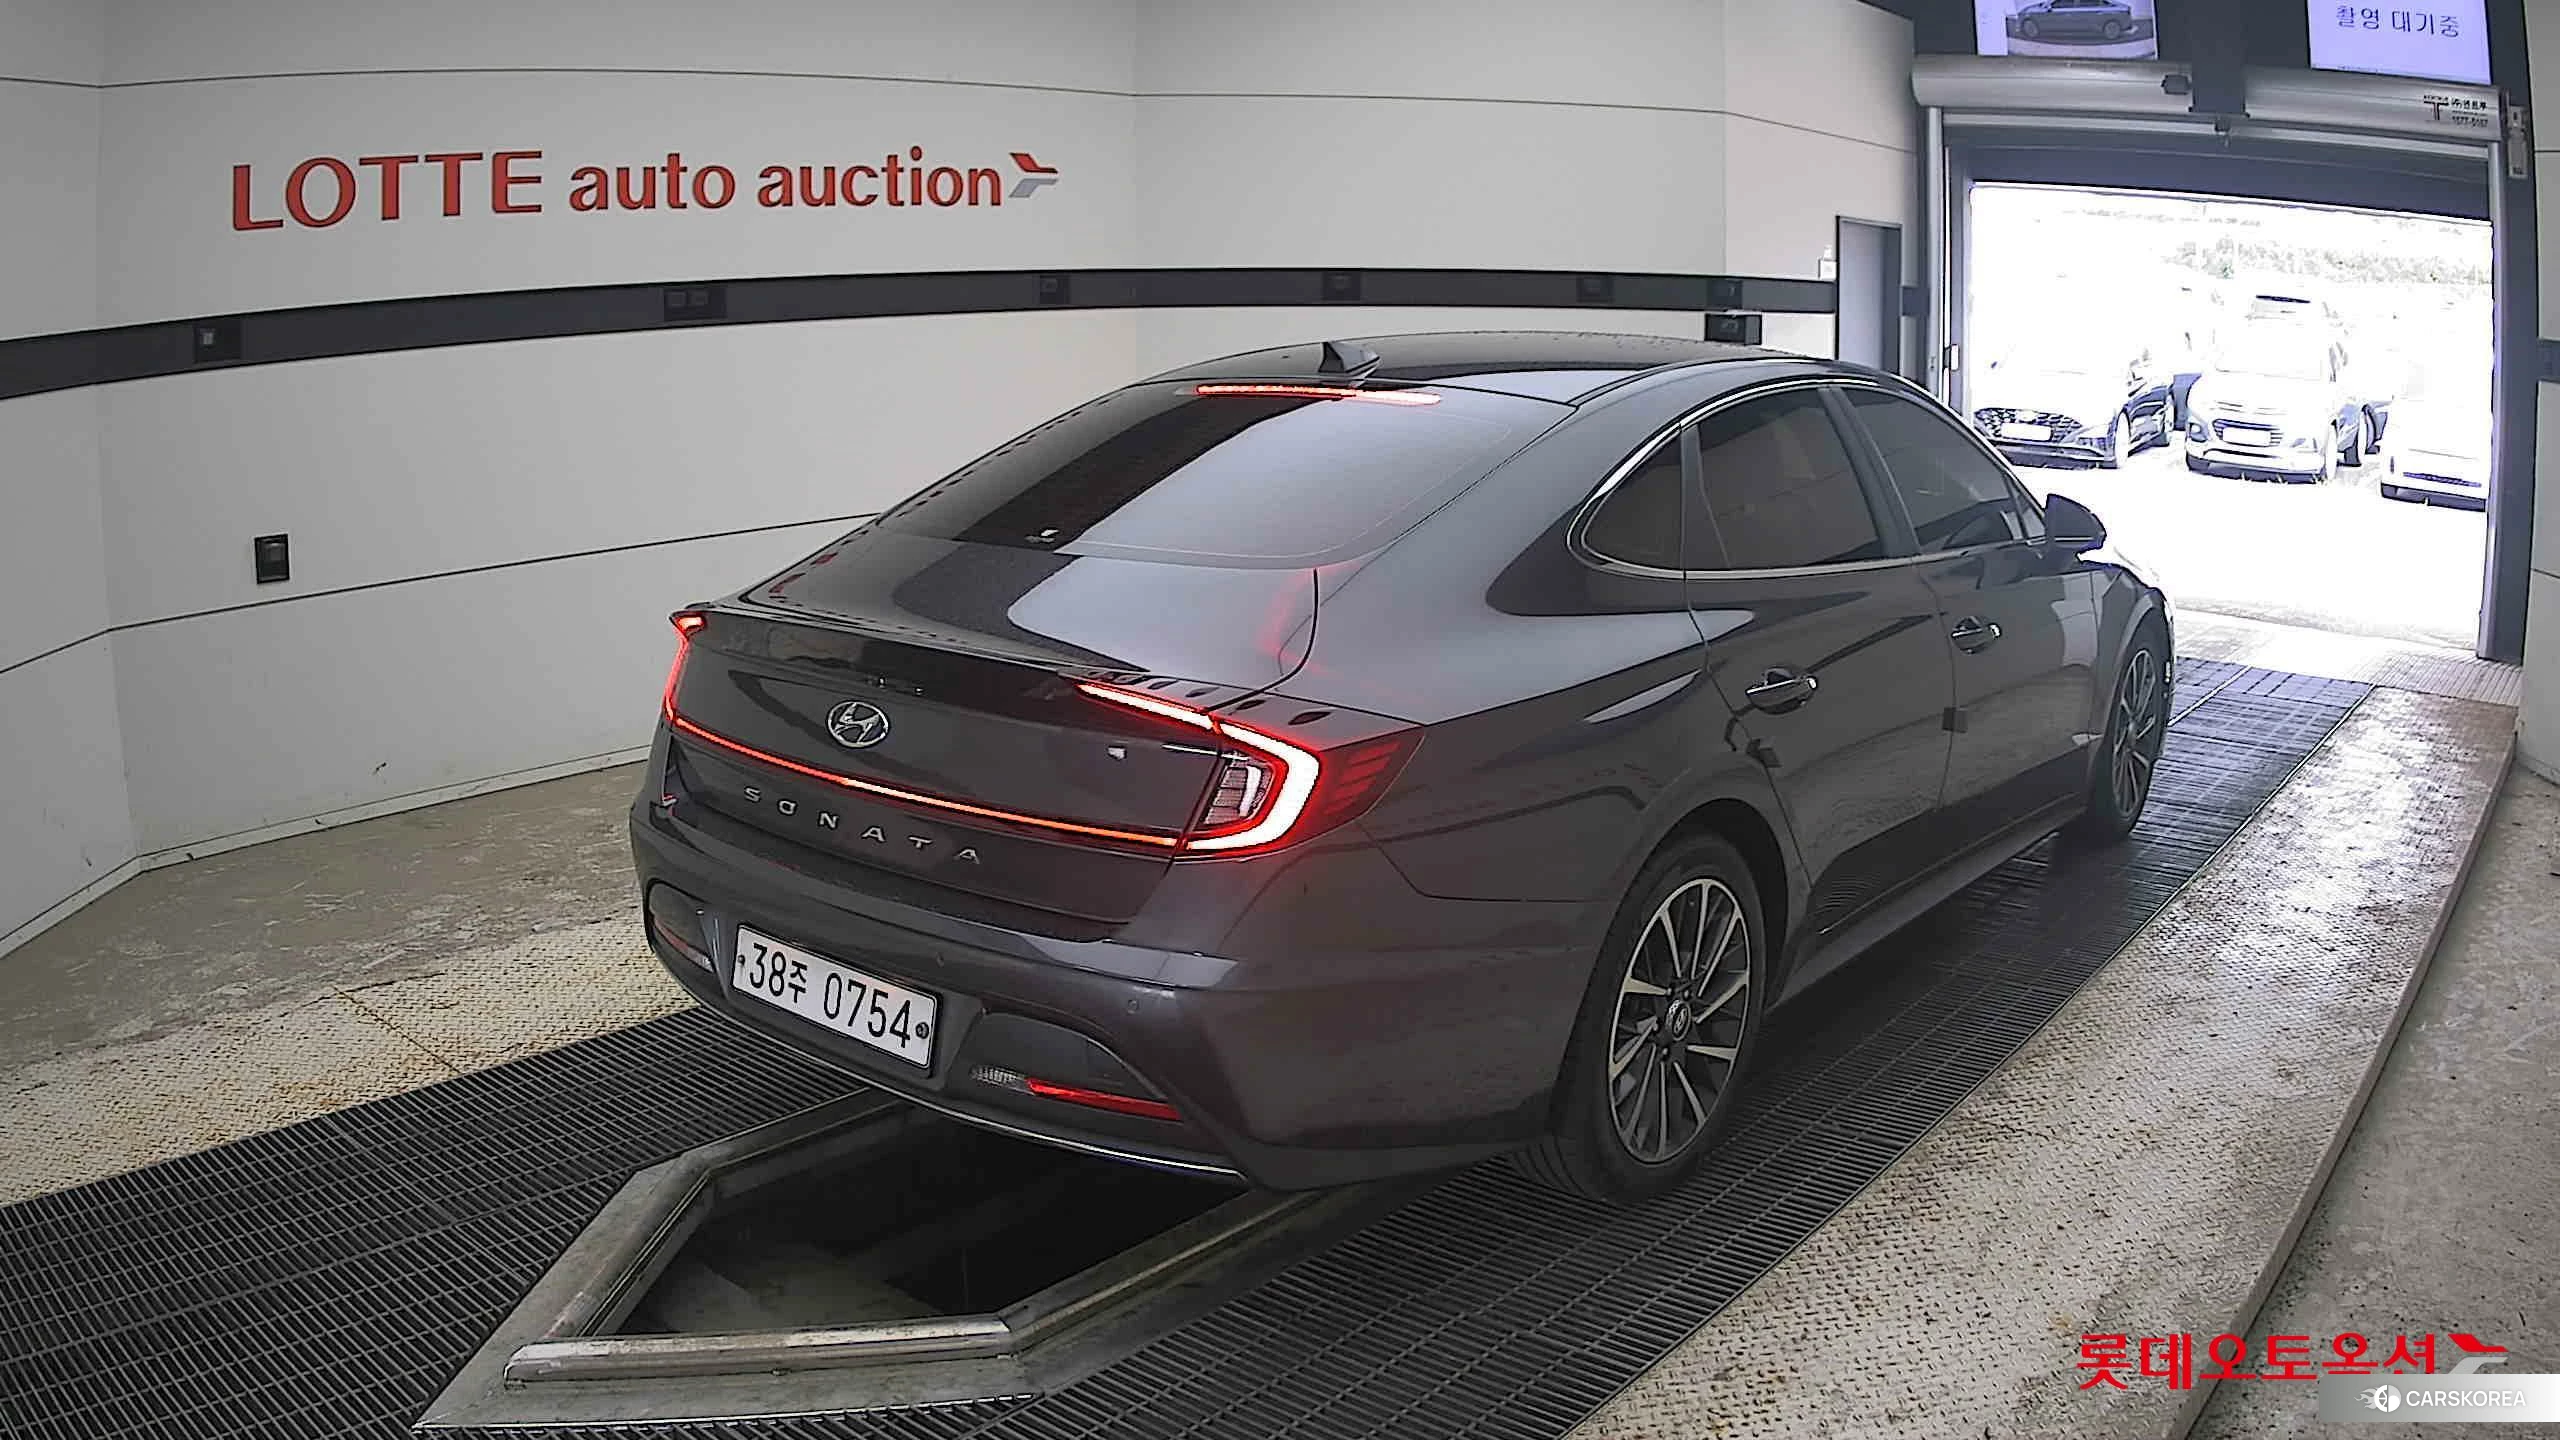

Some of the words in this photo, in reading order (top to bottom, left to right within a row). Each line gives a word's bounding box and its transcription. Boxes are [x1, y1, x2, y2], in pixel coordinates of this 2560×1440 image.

[2336, 5, 2380, 30] 촬영
[2392, 11, 2459, 38] 대기중
[232, 150, 543, 232] LOTTE
[568, 152, 736, 212] auto
[757, 145, 1003, 208] auction
[743, 786, 981, 865] SONATA
[749, 942, 808, 1004] 38주
[823, 972, 911, 1049] 0754
